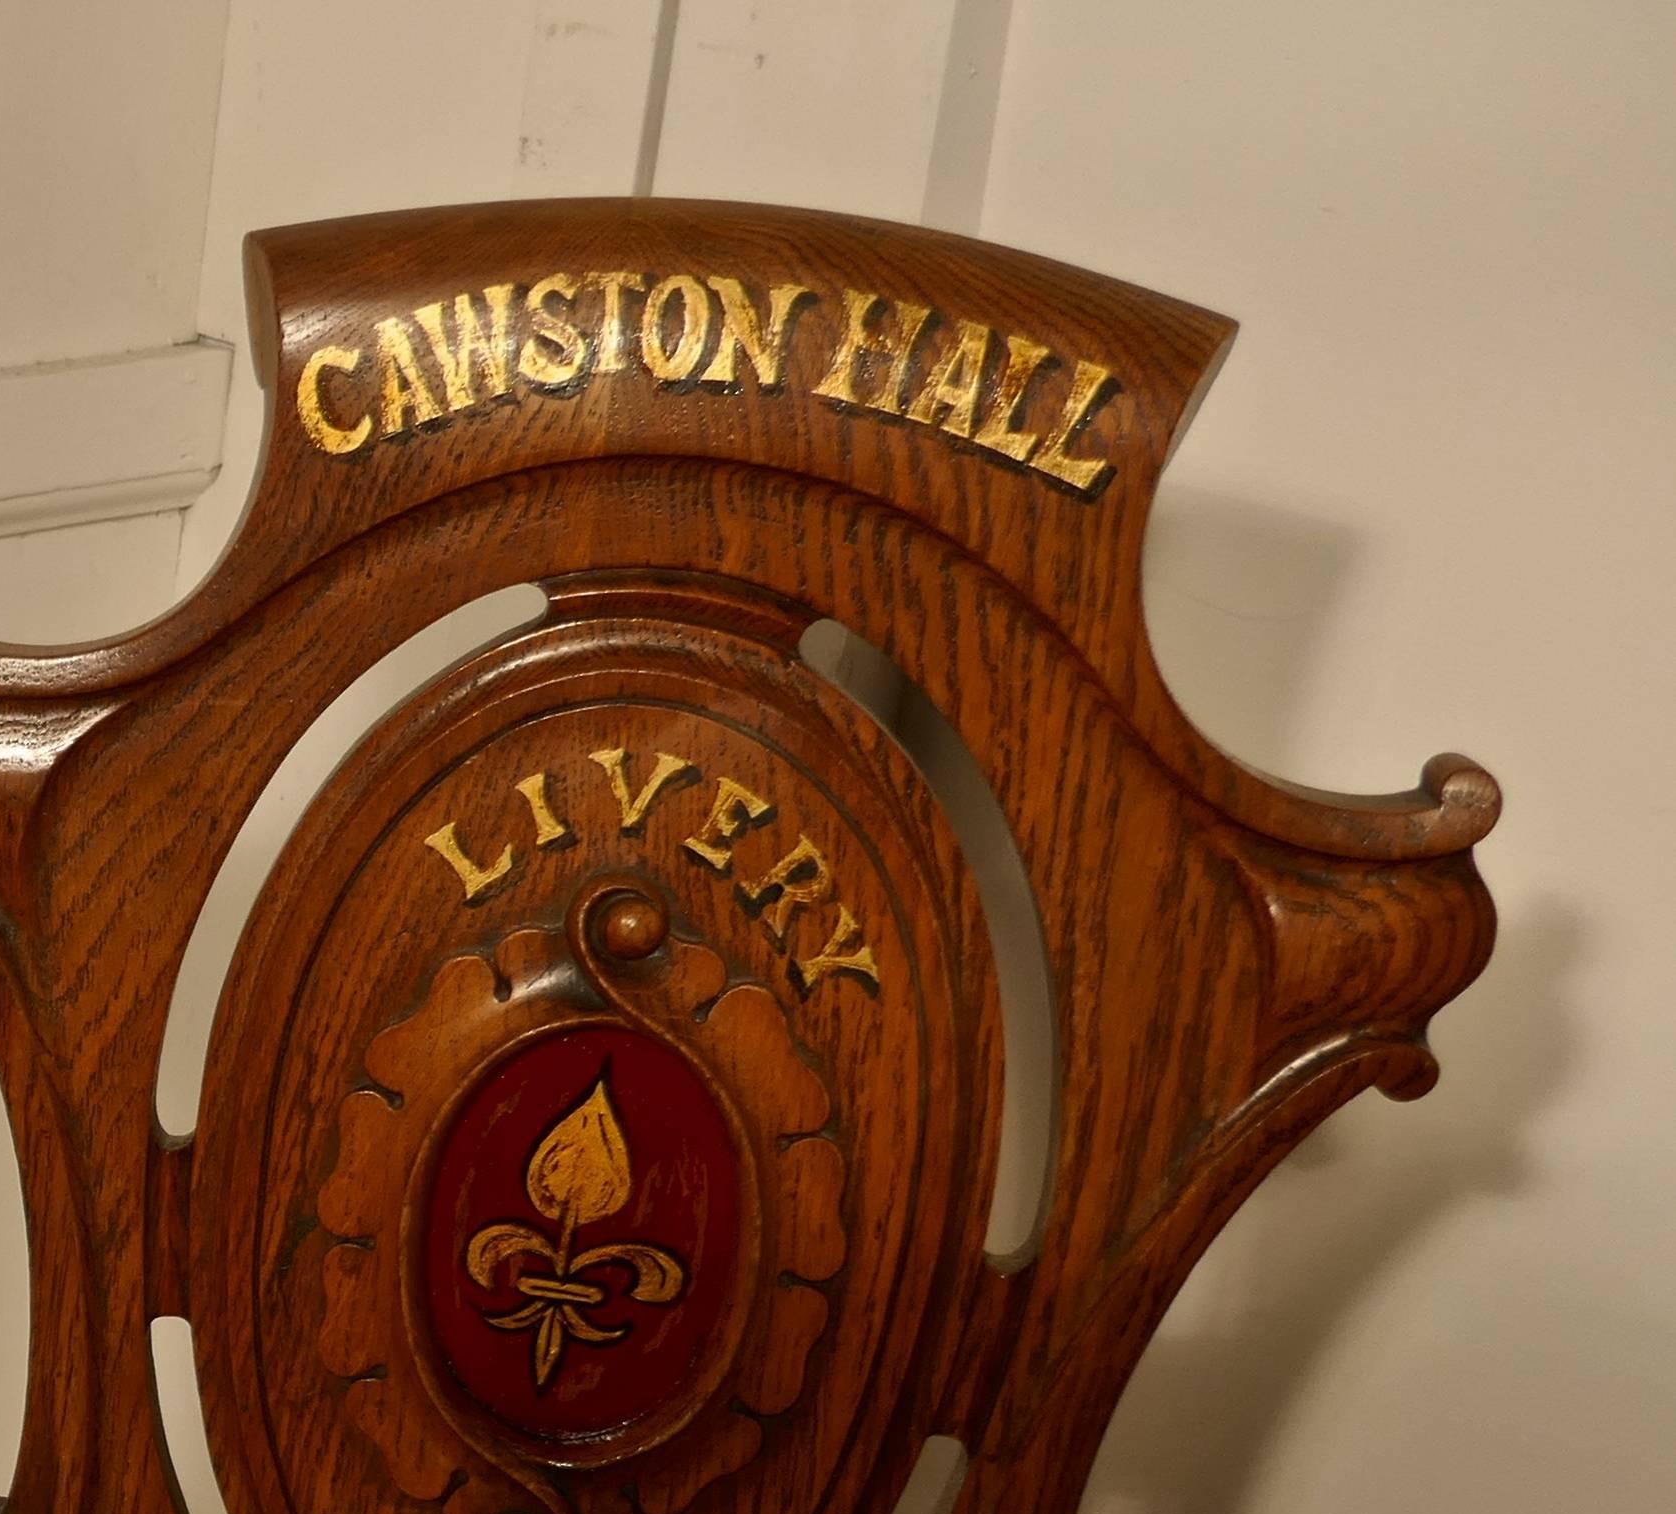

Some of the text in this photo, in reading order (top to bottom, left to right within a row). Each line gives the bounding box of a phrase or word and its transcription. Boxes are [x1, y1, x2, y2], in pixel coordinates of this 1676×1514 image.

[296, 271, 1123, 497] CAWSTON HALL
[424, 747, 881, 997] LIVERY
